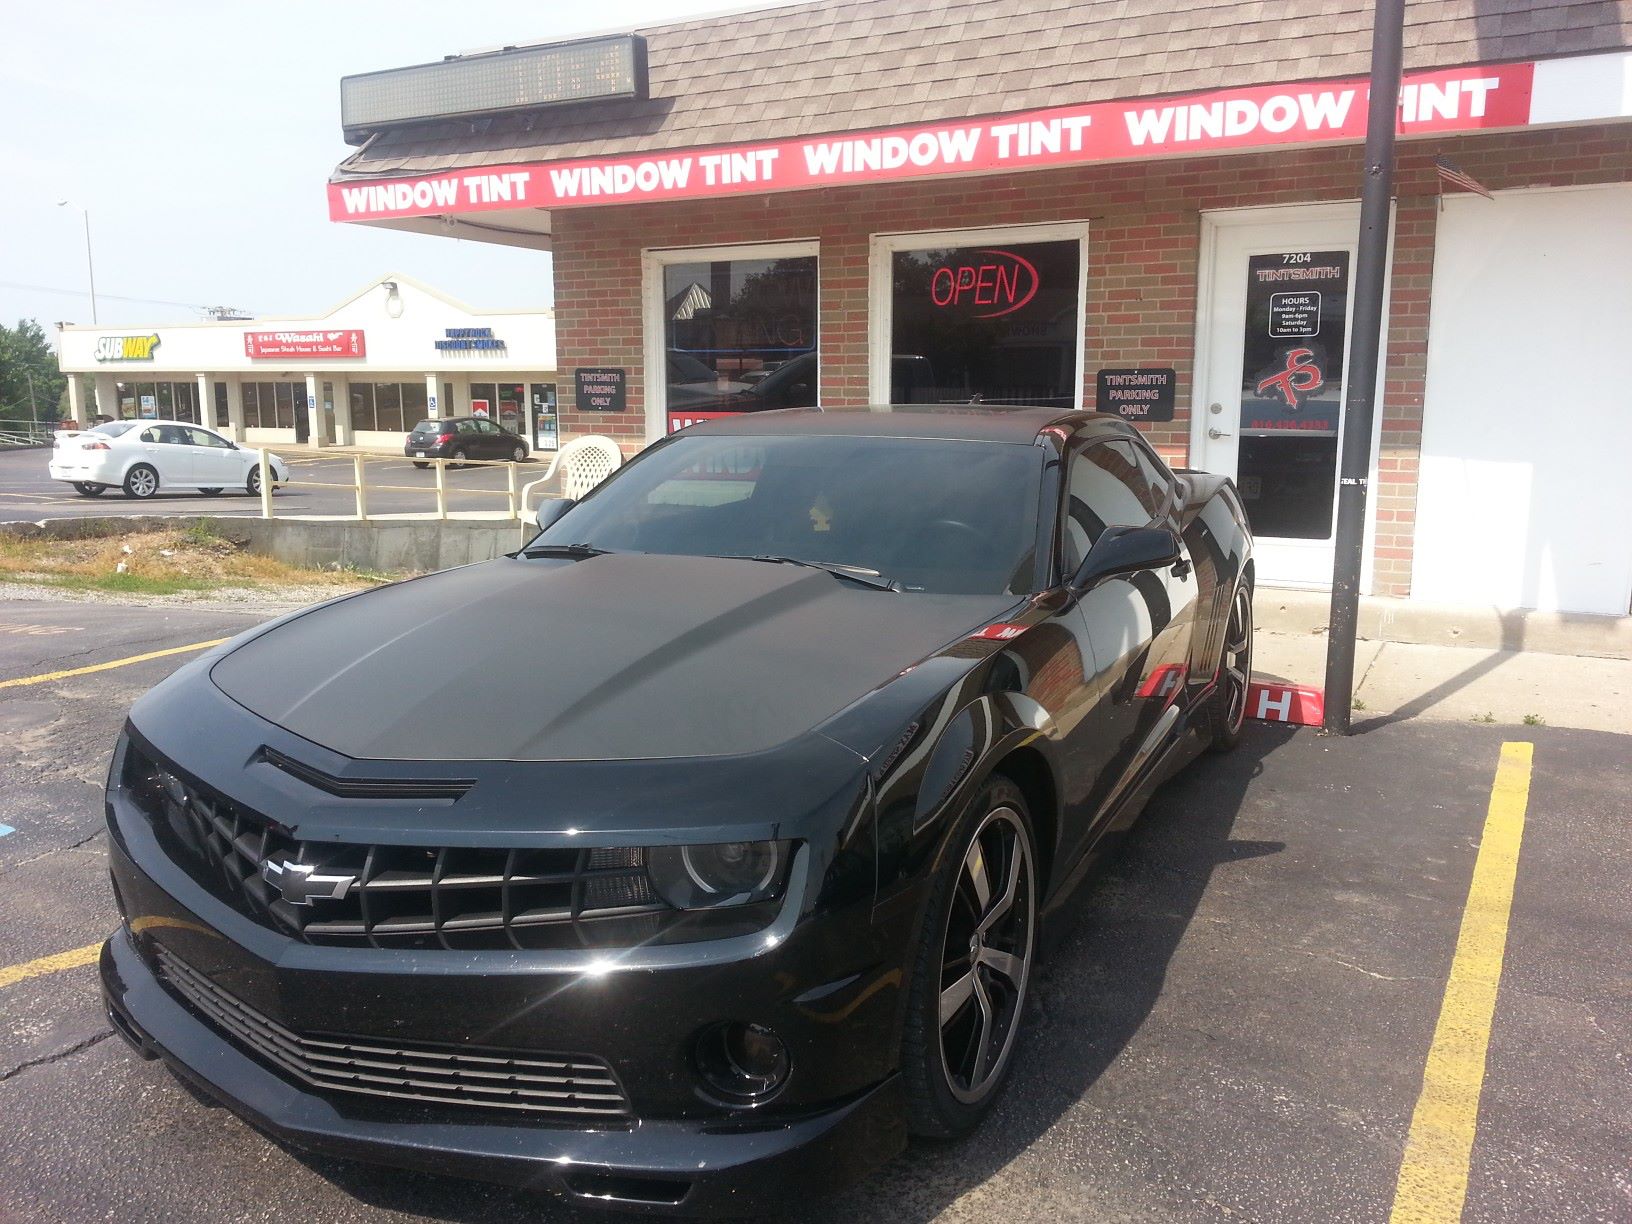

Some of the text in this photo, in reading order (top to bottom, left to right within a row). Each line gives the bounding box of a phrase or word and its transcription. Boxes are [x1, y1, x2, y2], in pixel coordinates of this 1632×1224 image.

[341, 77, 1499, 213] WINDOW TINT WINDOW TINT WINDOW TINT WINDOW INT
[1282, 253, 1311, 264] 7204
[1256, 266, 1340, 281] TINTSMITH
[931, 264, 1019, 306] OPEN
[1281, 297, 1310, 305] HOURS
[94, 333, 161, 361] SUBWAY
[580, 373, 620, 382] TINTSMITH
[1105, 374, 1167, 386] TINTSMITH
[583, 384, 616, 394] PARKING
[1109, 389, 1159, 400] PARKING
[591, 397, 610, 406] ONLY
[1119, 404, 1150, 415] ONLY
